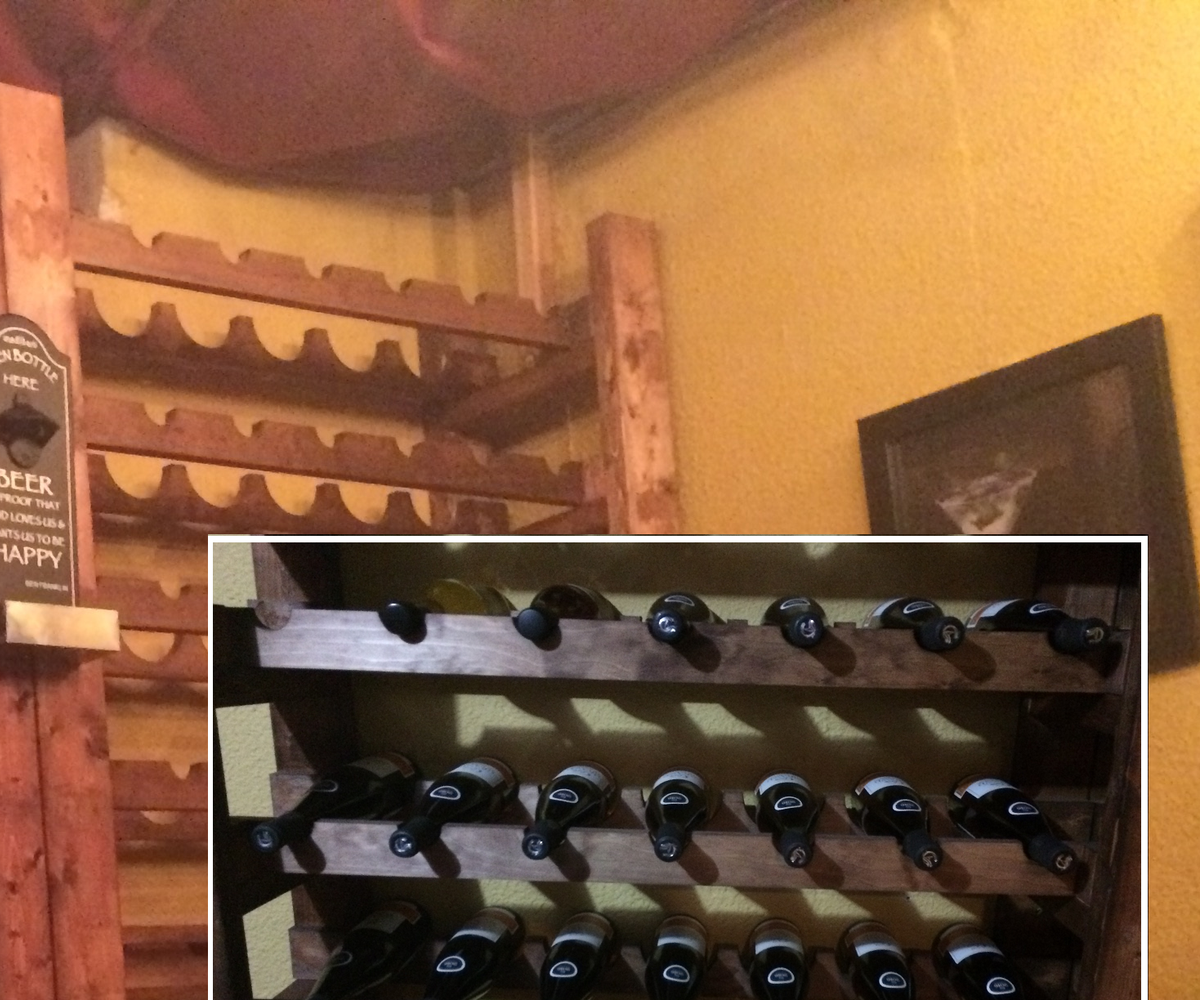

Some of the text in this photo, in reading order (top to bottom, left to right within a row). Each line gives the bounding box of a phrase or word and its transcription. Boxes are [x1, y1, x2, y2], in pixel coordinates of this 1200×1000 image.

[12, 348, 58, 383] BOTTLE
[3, 373, 39, 391] HERE
[0, 492, 32, 507] PROOF
[35, 498, 60, 511] THAT
[10, 512, 42, 527] LOVES
[20, 531, 35, 543] US
[36, 533, 51, 545] TO
[51, 535, 66, 547] BE
